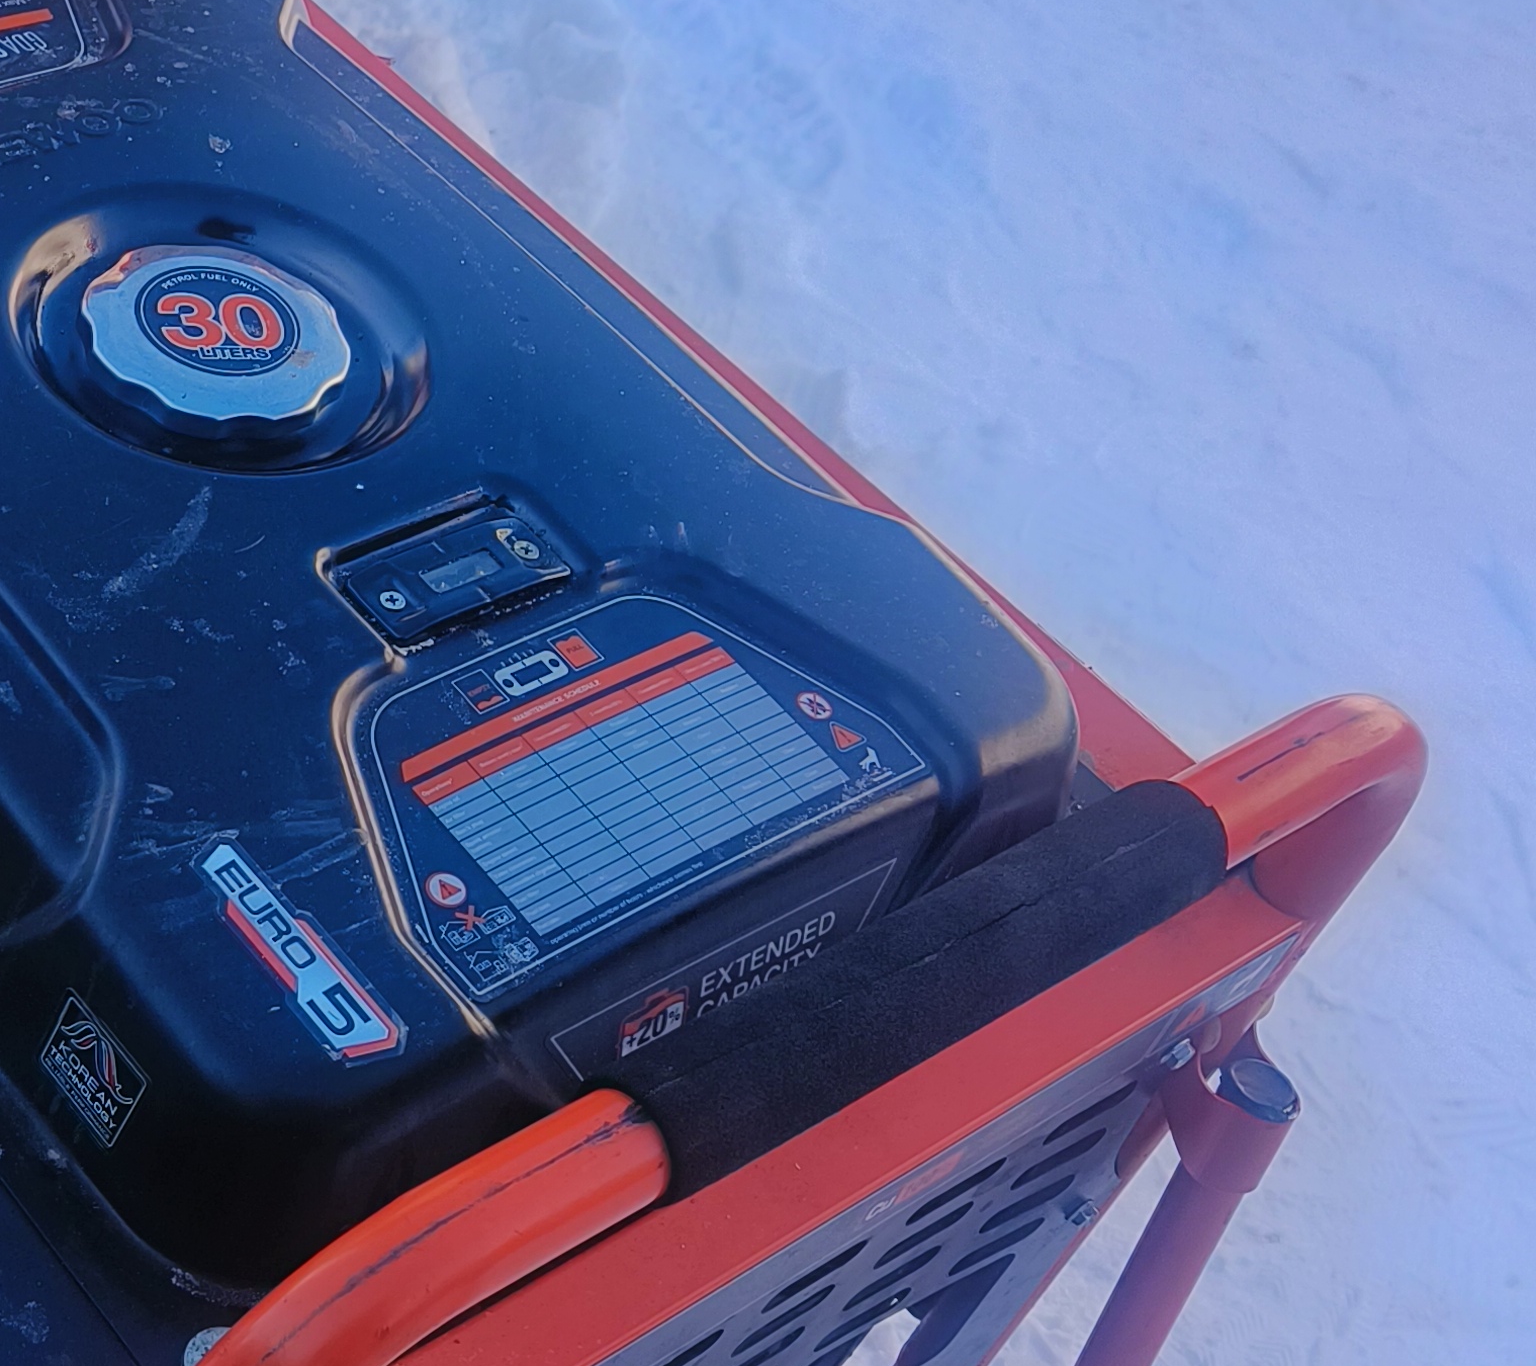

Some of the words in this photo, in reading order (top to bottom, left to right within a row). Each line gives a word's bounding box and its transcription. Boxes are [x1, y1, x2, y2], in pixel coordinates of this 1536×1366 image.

[161, 273, 199, 290] PETROL
[200, 273, 228, 283] FUEL
[231, 277, 260, 293] ONLY
[157, 292, 285, 350] 30
[197, 345, 272, 361] LITERS
[566, 644, 585, 655] FULL
[563, 679, 602, 700] SCHEDULE
[213, 859, 317, 970] EURO
[305, 981, 373, 1036] 5
[699, 910, 837, 998] EXTENDED
[49, 1044, 117, 1131] TECHNOLOGY
[58, 1040, 119, 1117] KOREAN
